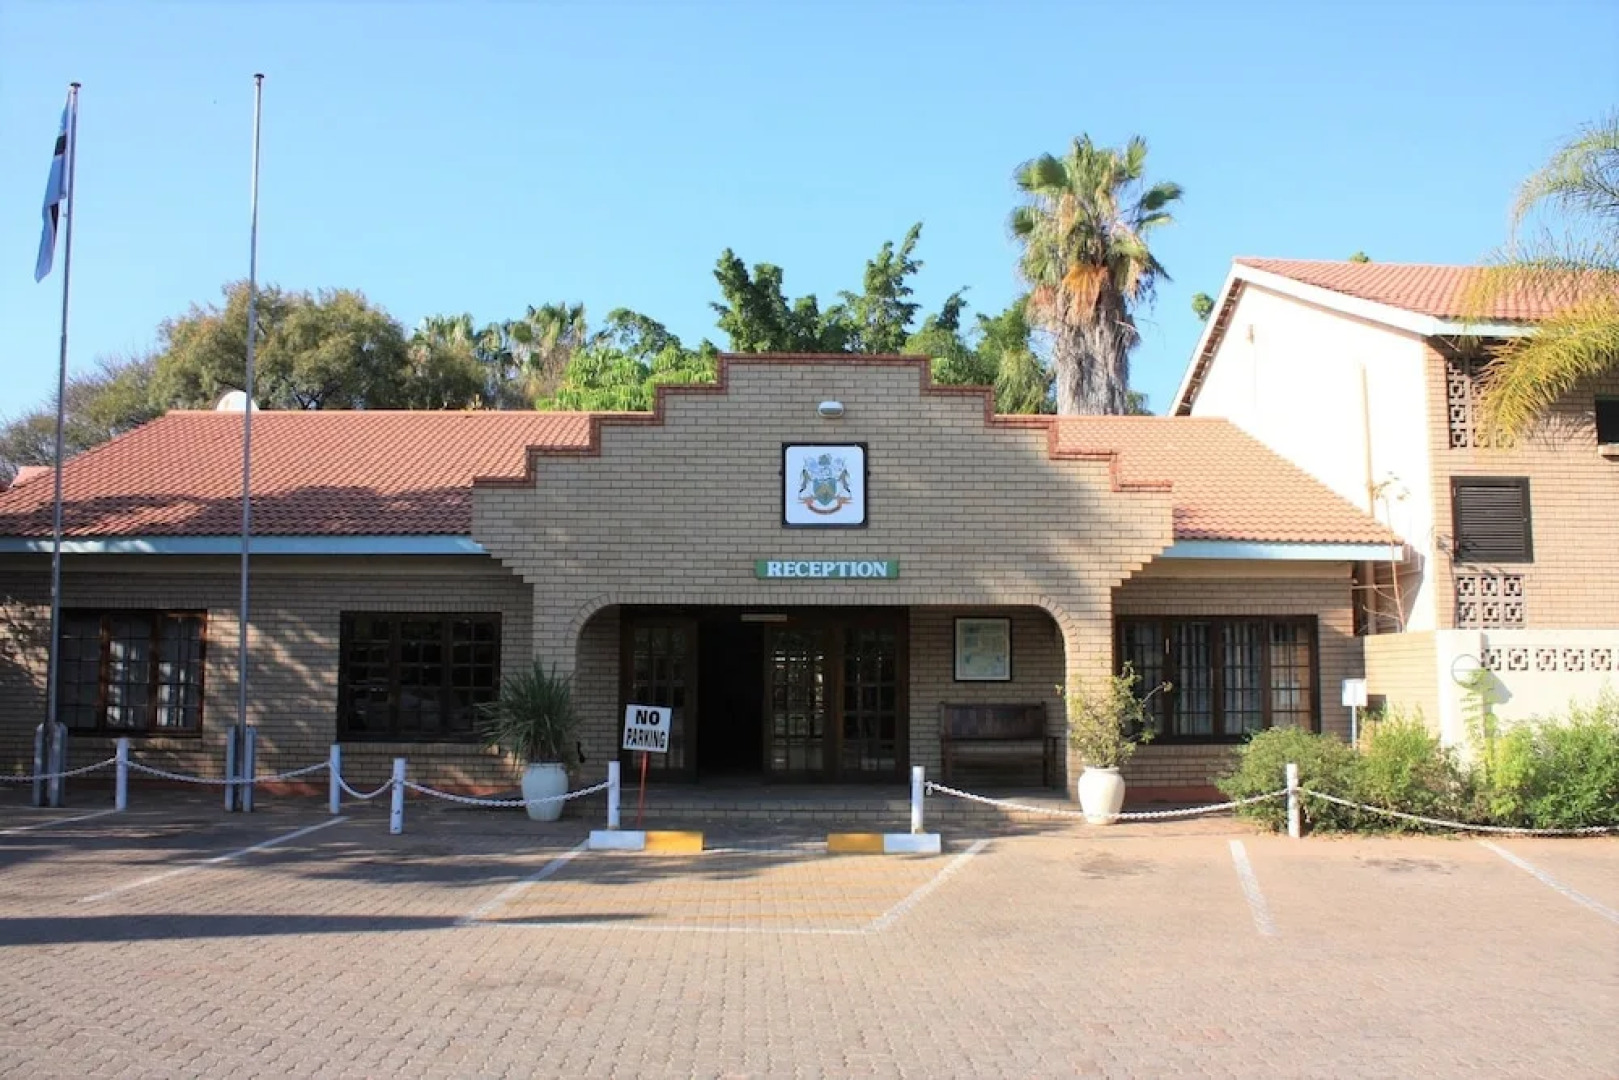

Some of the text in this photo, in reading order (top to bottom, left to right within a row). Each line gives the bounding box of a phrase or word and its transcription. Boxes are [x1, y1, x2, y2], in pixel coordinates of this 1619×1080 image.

[766, 561, 888, 577] RECEPTION
[636, 710, 660, 726] NO
[626, 728, 666, 749] PARKING
